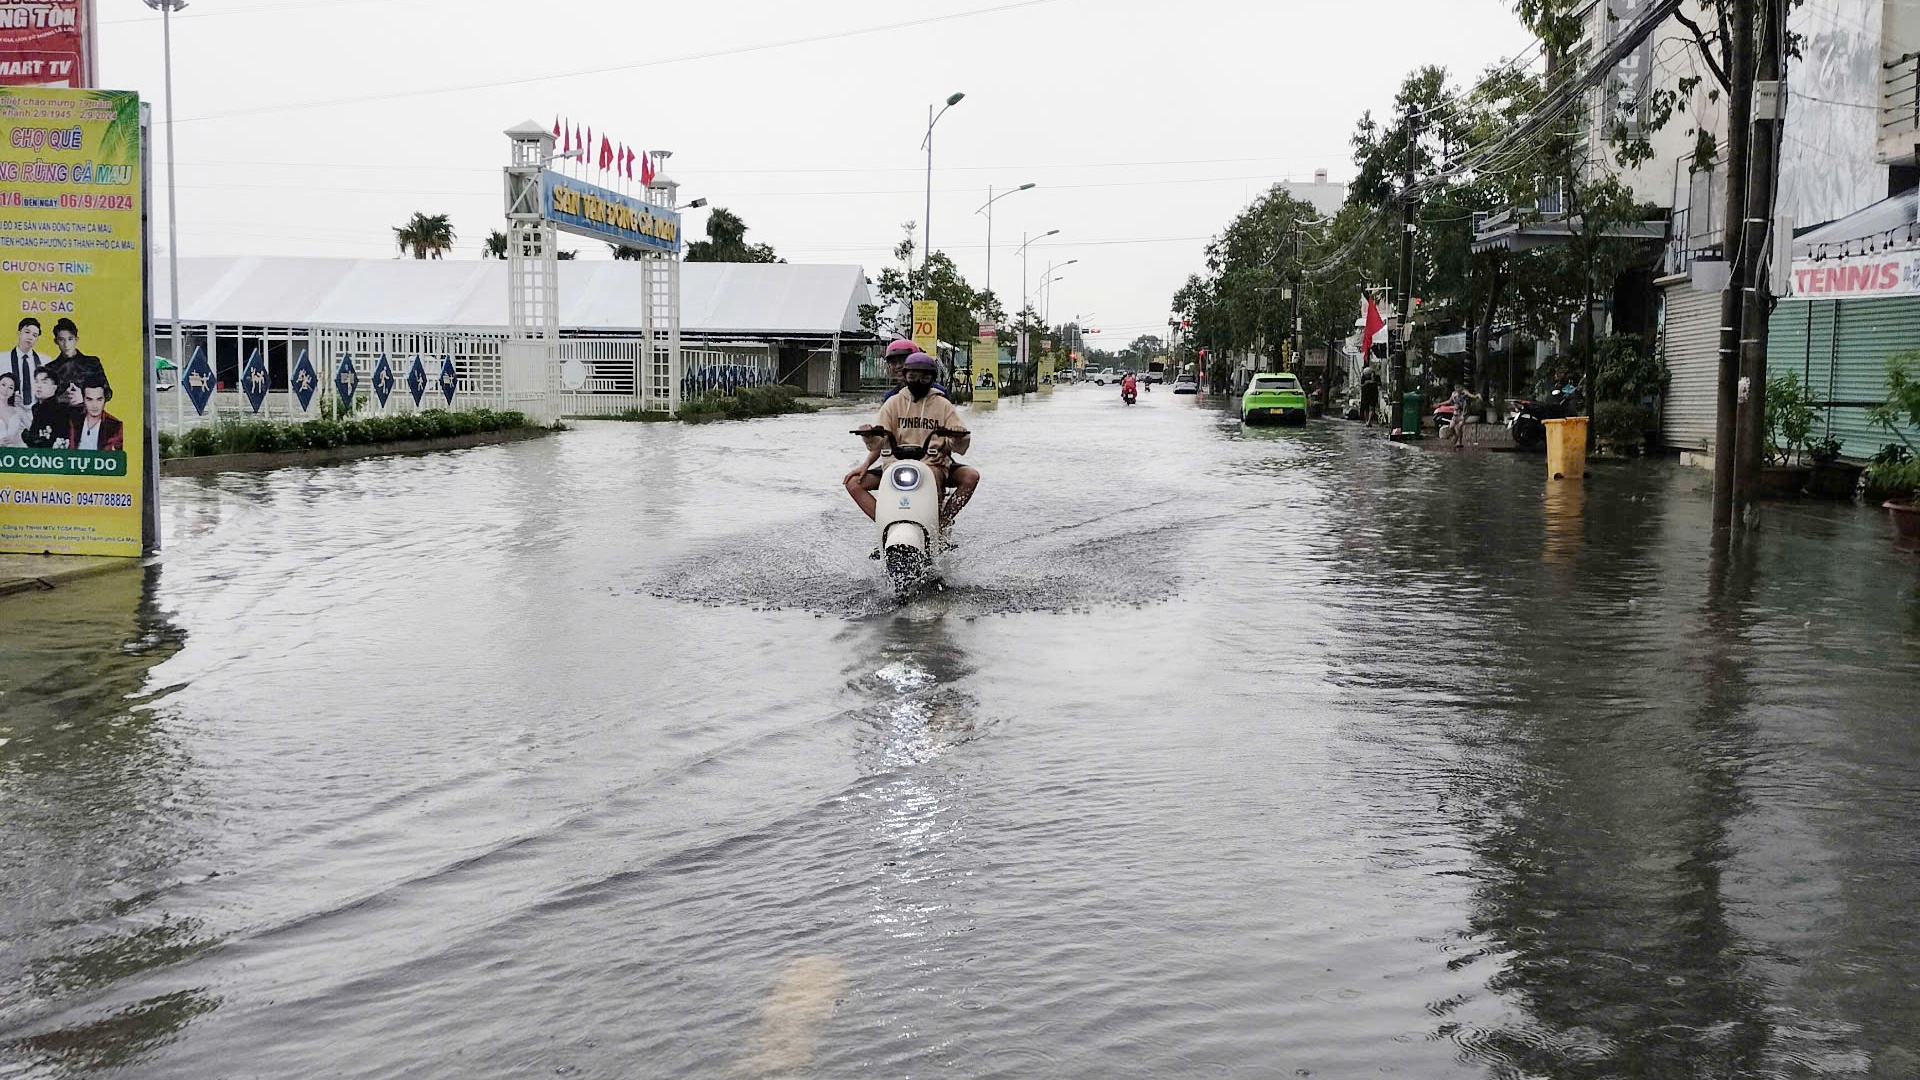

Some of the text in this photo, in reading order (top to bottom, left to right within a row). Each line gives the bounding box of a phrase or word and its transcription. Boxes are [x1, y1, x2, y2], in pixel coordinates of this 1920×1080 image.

[49, 60, 71, 75] TV
[11, 125, 82, 152] CHỢ QUÊ
[23, 158, 68, 183] RỪNG
[72, 160, 92, 184] CÀ
[96, 165, 131, 185] MAU
[61, 193, 132, 209] 06/9/2024
[2, 261, 93, 274] CHƯƠNG TRÌNH
[1794, 262, 1900, 293] TENNIS
[21, 281, 74, 294] CA NHẠC
[914, 321, 933, 336] 70
[0, 455, 15, 468] O
[67, 456, 91, 472] TỰ
[94, 458, 117, 471] DO
[14, 490, 39, 504] GIAN
[76, 492, 132, 507] 0947788828
